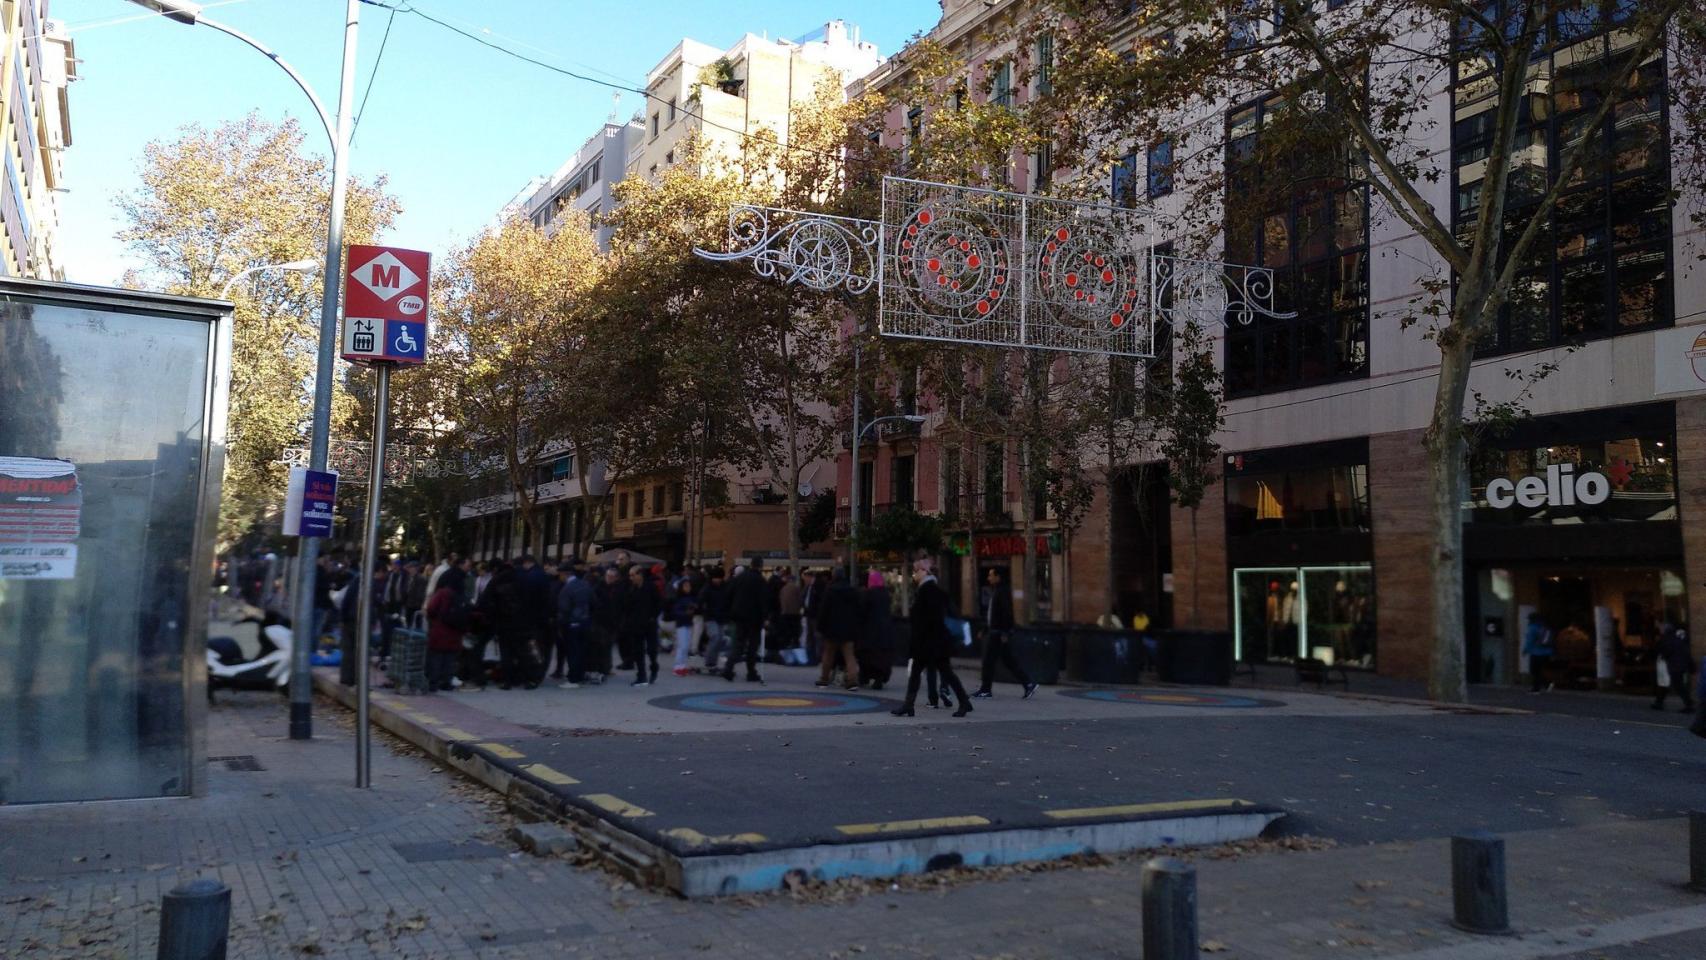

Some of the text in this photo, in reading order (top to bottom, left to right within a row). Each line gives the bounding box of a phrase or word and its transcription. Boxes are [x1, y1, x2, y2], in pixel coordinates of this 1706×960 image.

[371, 263, 401, 289] M
[402, 301, 421, 310] TMB
[1485, 463, 1610, 509] celio
[976, 535, 1050, 555] FARMAA
